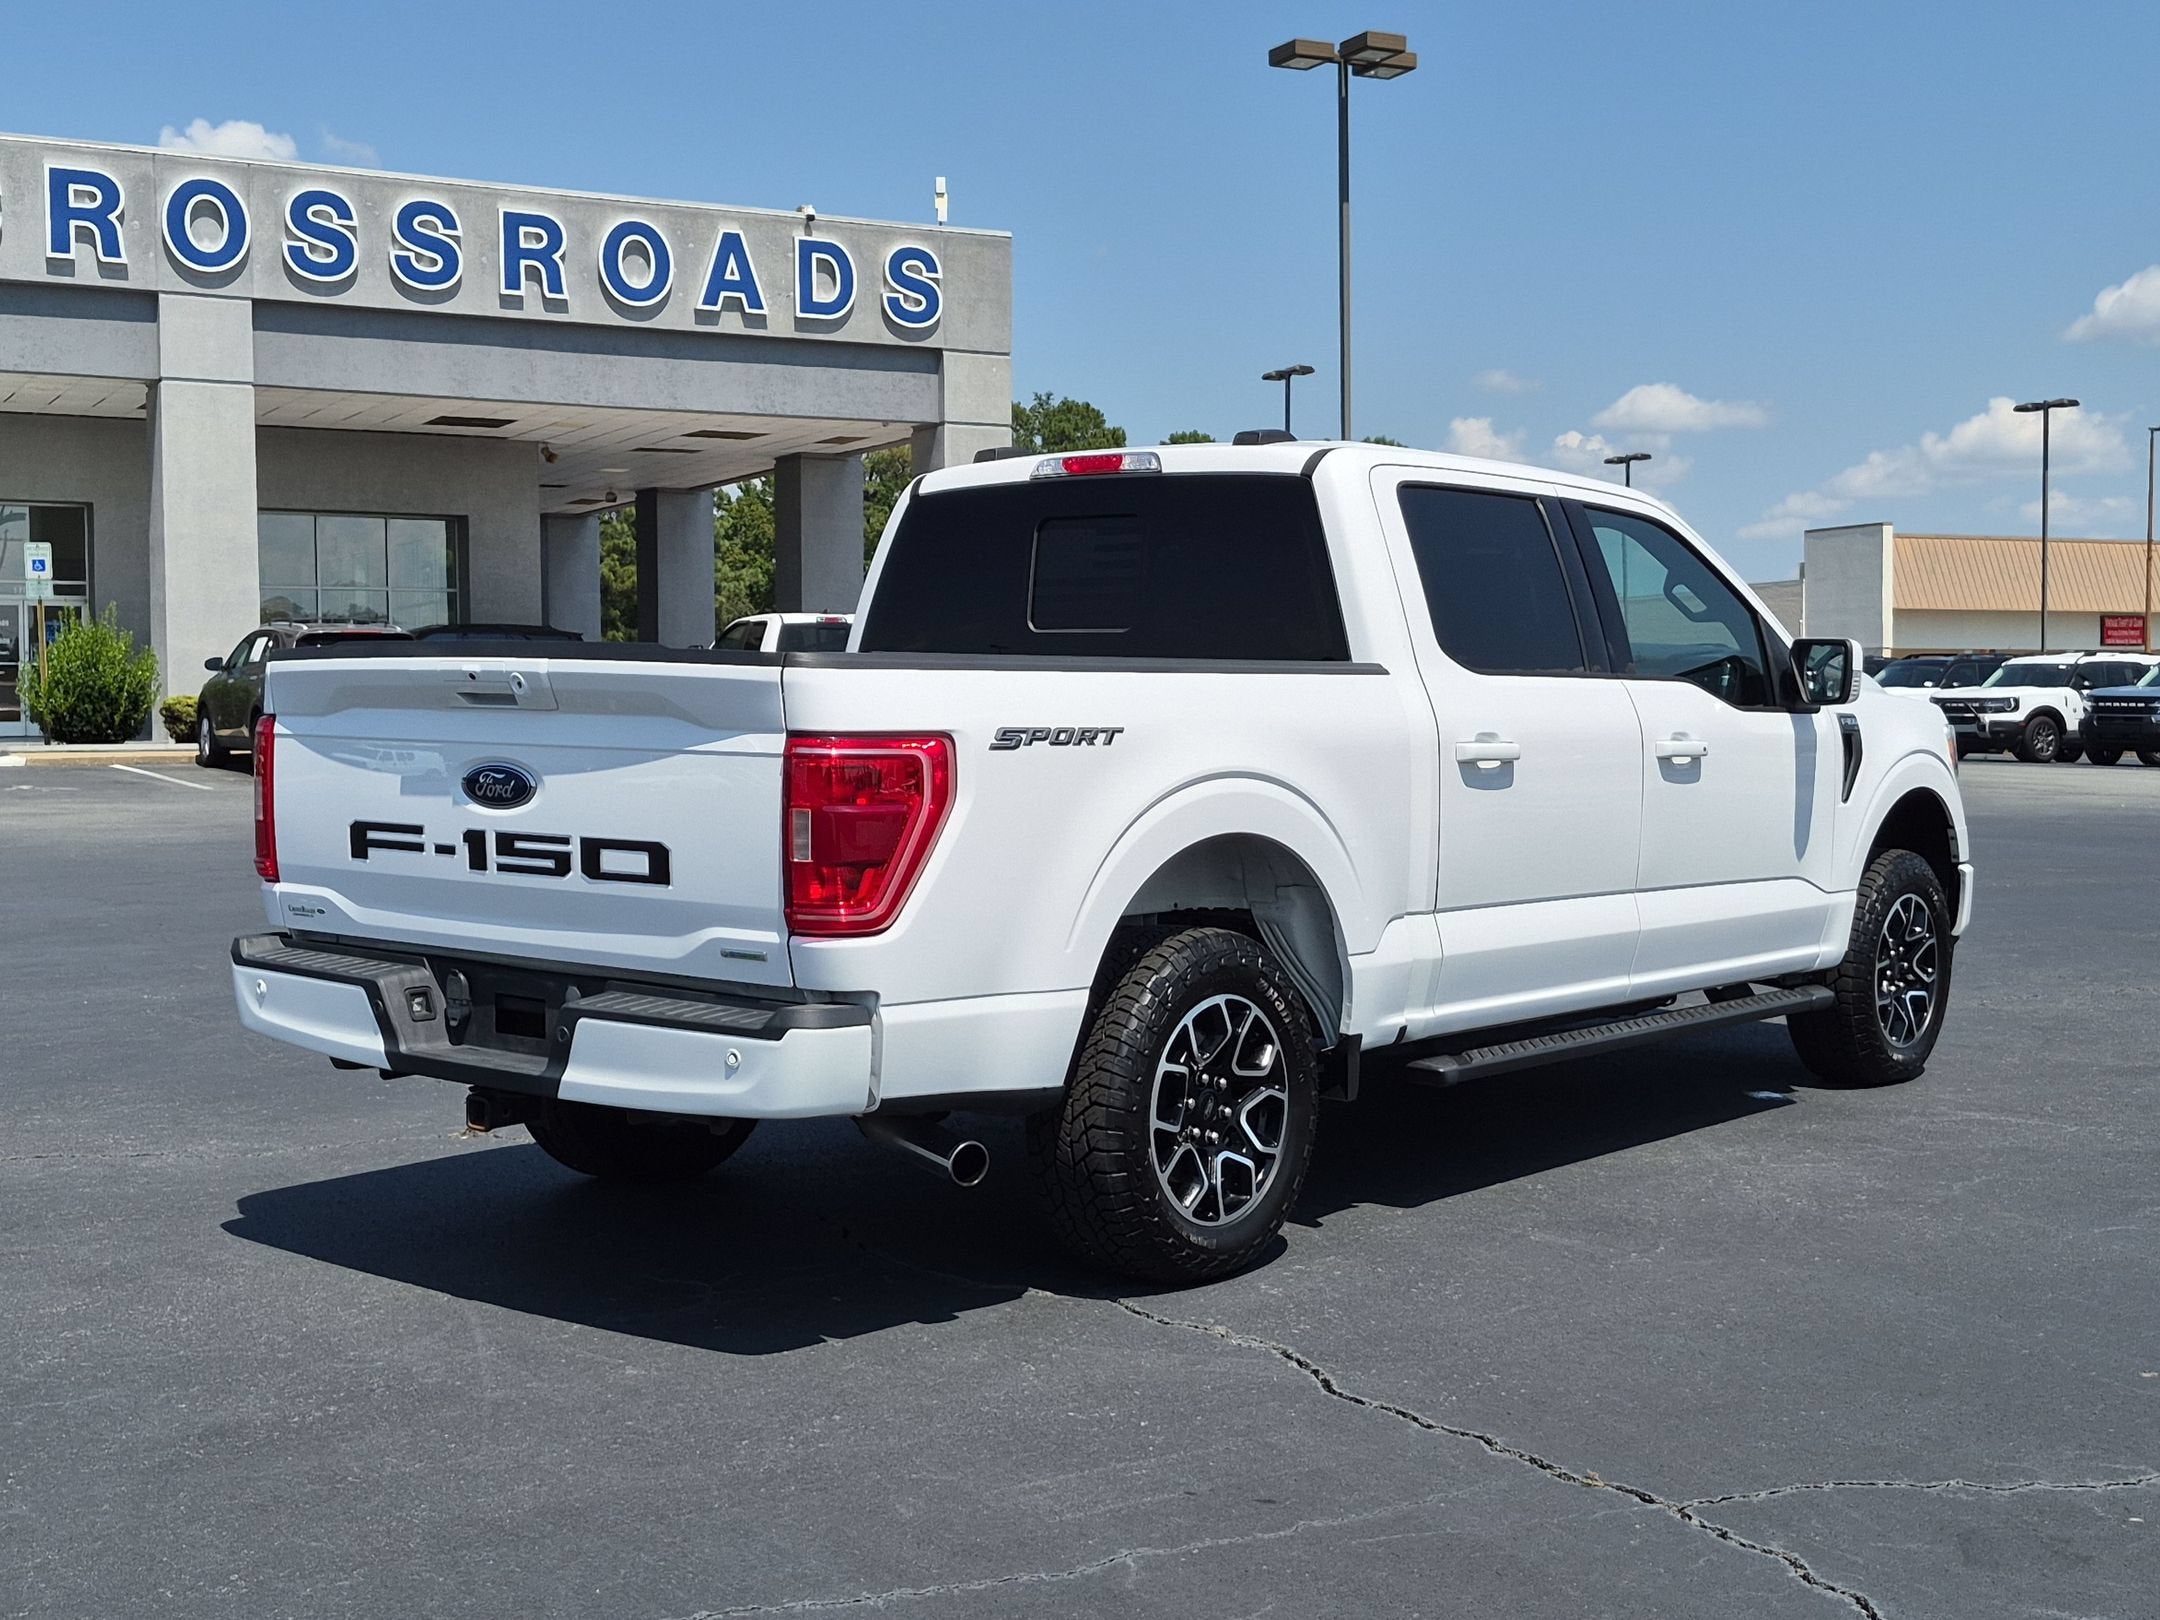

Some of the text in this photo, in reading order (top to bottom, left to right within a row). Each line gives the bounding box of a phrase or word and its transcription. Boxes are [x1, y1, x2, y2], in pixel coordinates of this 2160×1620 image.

[0, 163, 943, 328] ROSSROADS
[988, 726, 1125, 751] SPORT
[475, 771, 515, 798] Ford
[349, 819, 672, 887] F-150
